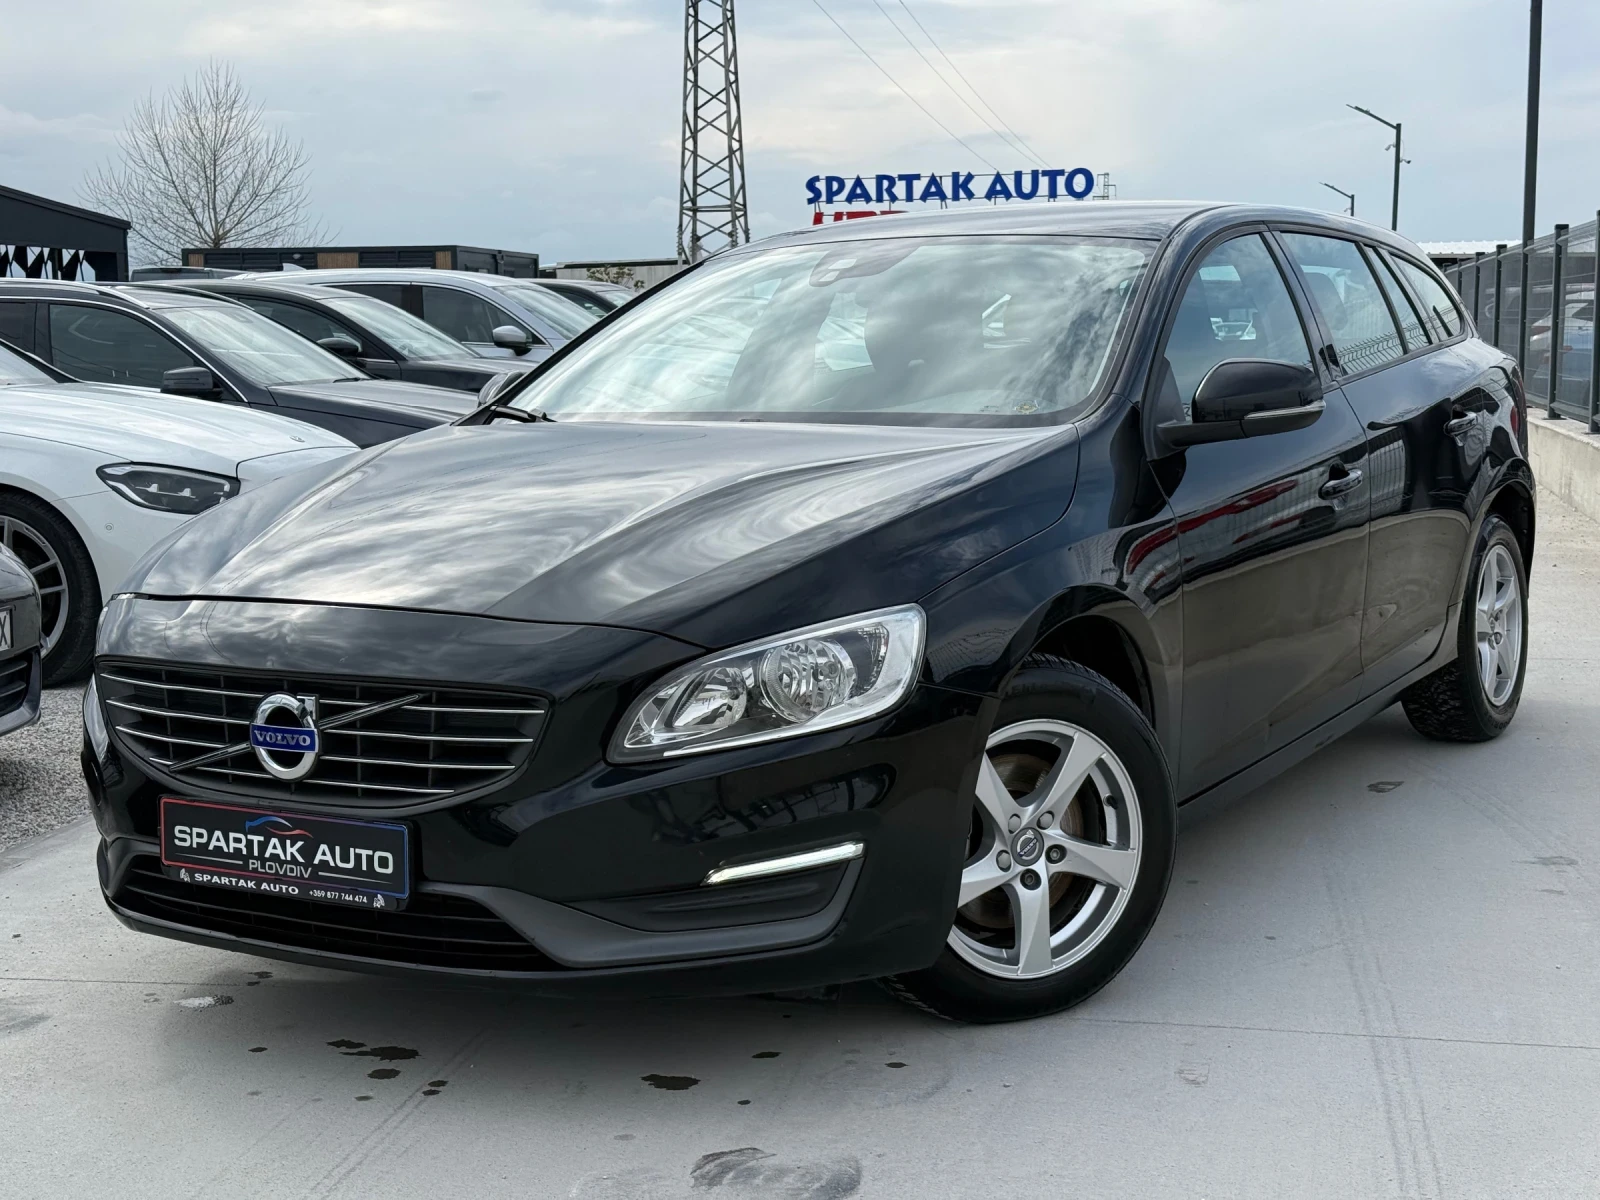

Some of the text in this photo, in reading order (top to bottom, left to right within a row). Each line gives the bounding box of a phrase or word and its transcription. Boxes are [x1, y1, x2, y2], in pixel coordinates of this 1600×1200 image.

[805, 168, 1094, 205] SPARTAK AUTO
[254, 730, 311, 746] VOLVO
[174, 825, 394, 874] SPARTAK AUTO
[249, 859, 312, 879] PLOVDIV
[194, 873, 299, 894] SPARTAK AUTO
[309, 889, 367, 904] +359 877 744 474
